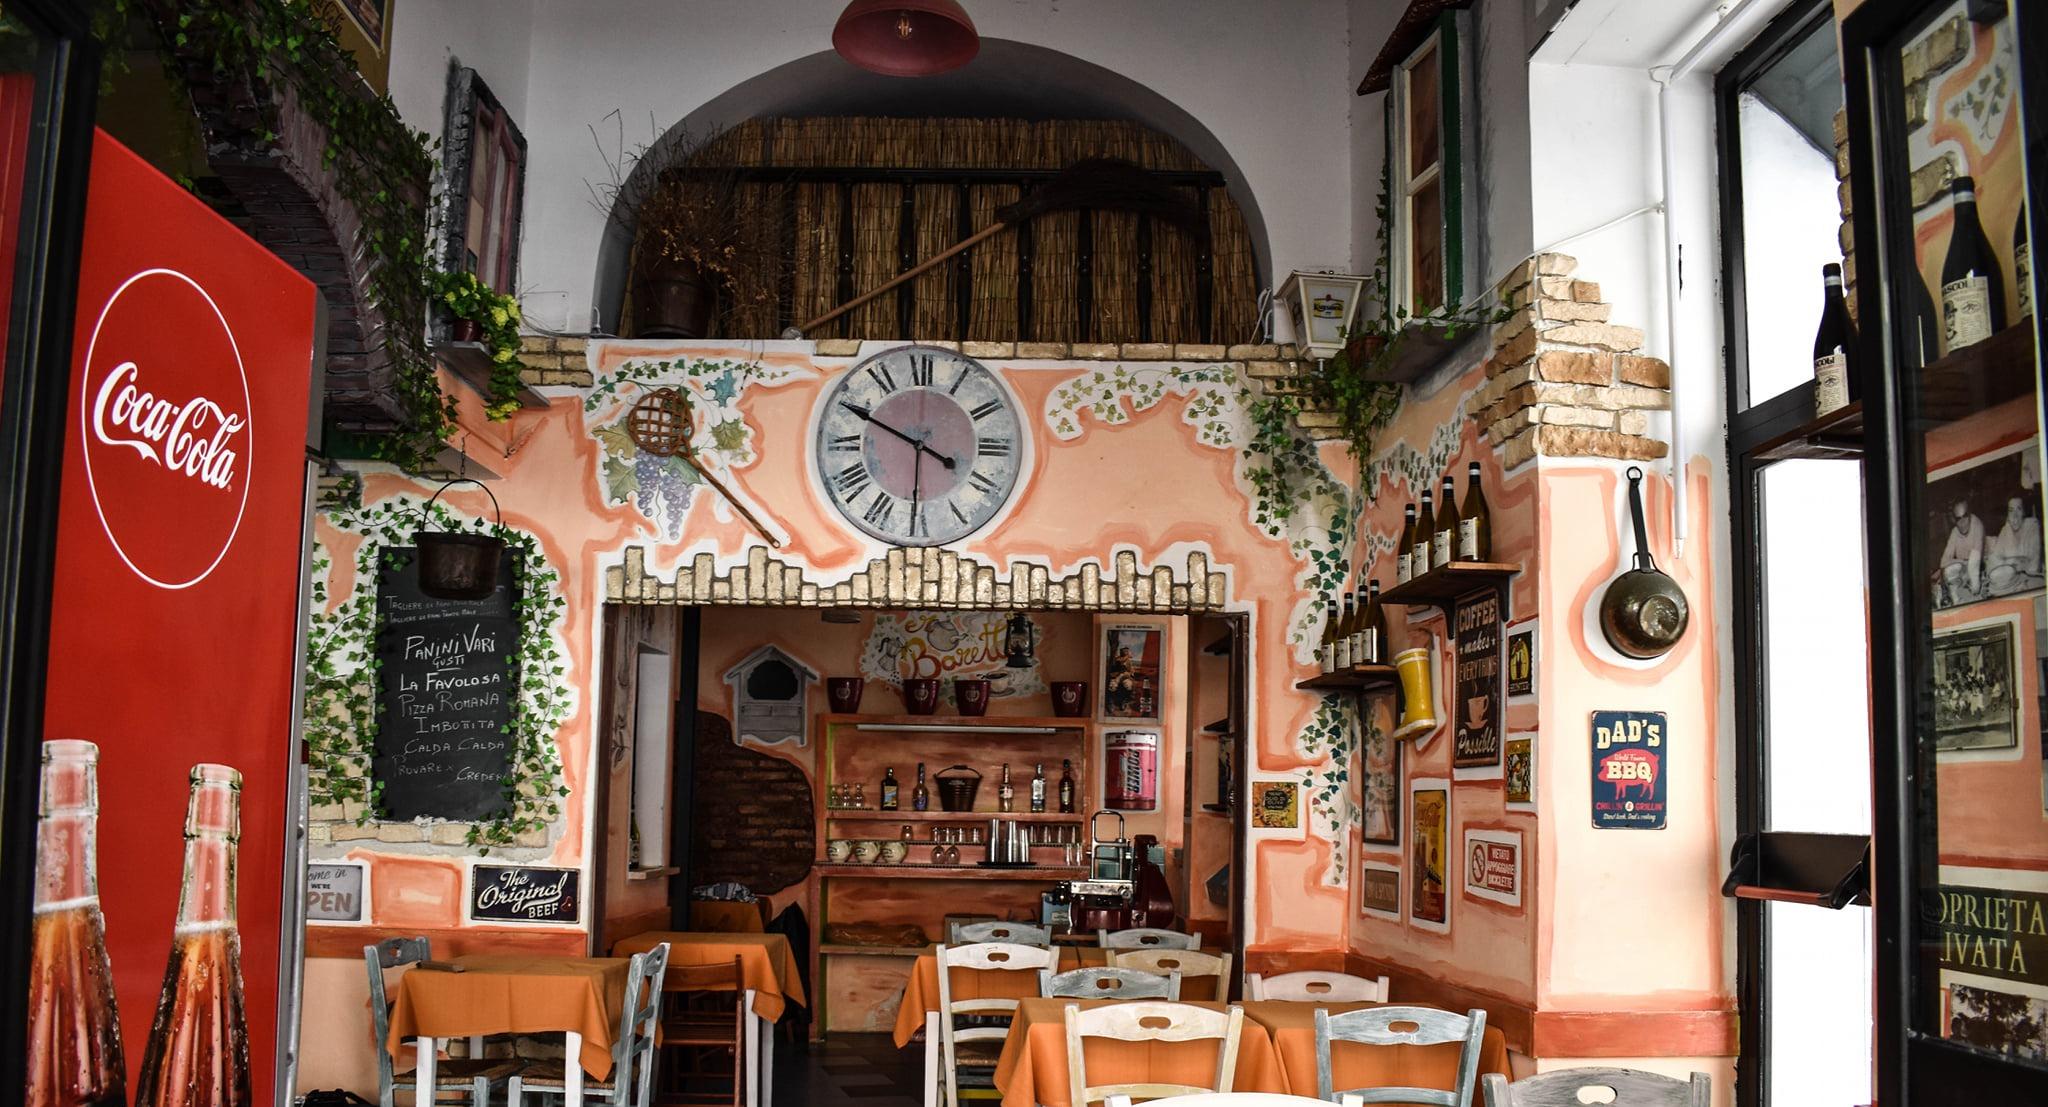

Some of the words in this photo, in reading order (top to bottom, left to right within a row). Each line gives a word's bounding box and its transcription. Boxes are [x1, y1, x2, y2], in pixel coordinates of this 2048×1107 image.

[94, 362, 247, 489] Coca-Cola
[1459, 599, 1496, 632] COFFEE
[903, 621, 1010, 680] Barett
[1465, 631, 1491, 654] makes
[433, 655, 465, 668] GUSTI
[1459, 655, 1497, 683] EVERYTHING
[426, 673, 500, 692] FAVOLOSA
[398, 693, 434, 717] PIZZA
[436, 691, 499, 711] ROMANA
[414, 716, 495, 734] IMBOTTITA
[1596, 719, 1660, 749] DAD'S
[404, 738, 451, 755] CALDA
[457, 738, 504, 752] CALDA
[1457, 727, 1496, 757] Possible
[1606, 761, 1652, 784] BBQ
[308, 870, 331, 880] ome
[500, 868, 530, 889] The
[308, 891, 352, 912] PEN
[477, 872, 568, 913] Original
[528, 902, 559, 918] BEEF
[1940, 931, 2028, 974] IVATA
